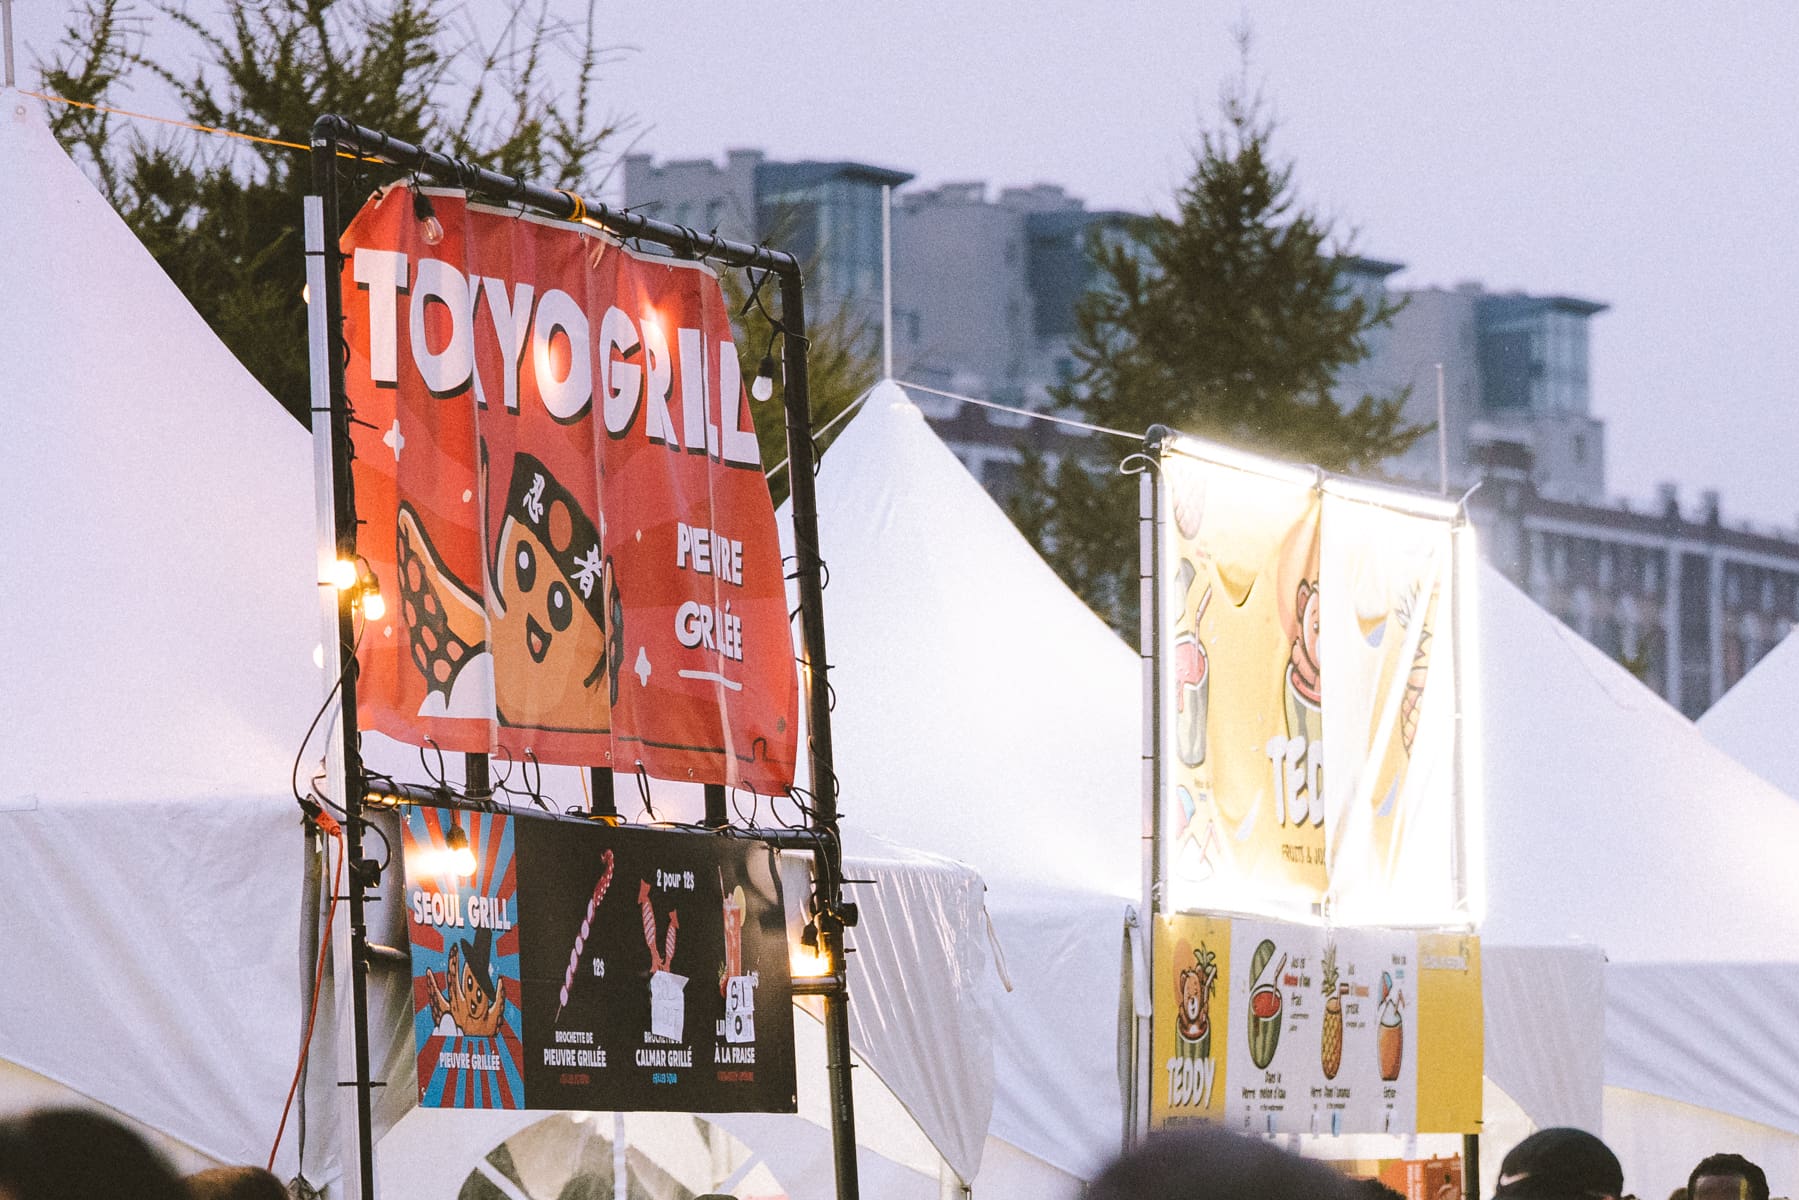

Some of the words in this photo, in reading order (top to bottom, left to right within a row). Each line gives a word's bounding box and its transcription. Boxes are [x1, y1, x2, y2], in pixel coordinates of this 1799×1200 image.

[656, 869, 662, 887] 2
[663, 872, 681, 892] pour
[683, 872, 694, 891] 12$
[413, 891, 465, 928] SEOUL
[468, 895, 512, 931] GRILL
[593, 958, 605, 978] 12$
[555, 1030, 585, 1044] BROCHETTE
[586, 1031, 593, 1044] DE
[439, 1052, 470, 1070] PIEUVRE
[471, 1050, 500, 1071] GRILLÉE
[544, 1048, 576, 1067] PIEUVRE
[577, 1045, 606, 1068] GRILLÉE
[635, 1048, 666, 1067] CALMAR
[668, 1045, 692, 1068] GRILLÉ
[721, 1047, 731, 1064] LA
[732, 1047, 755, 1064] FRAISE
[1166, 1056, 1215, 1109] TEDDY
